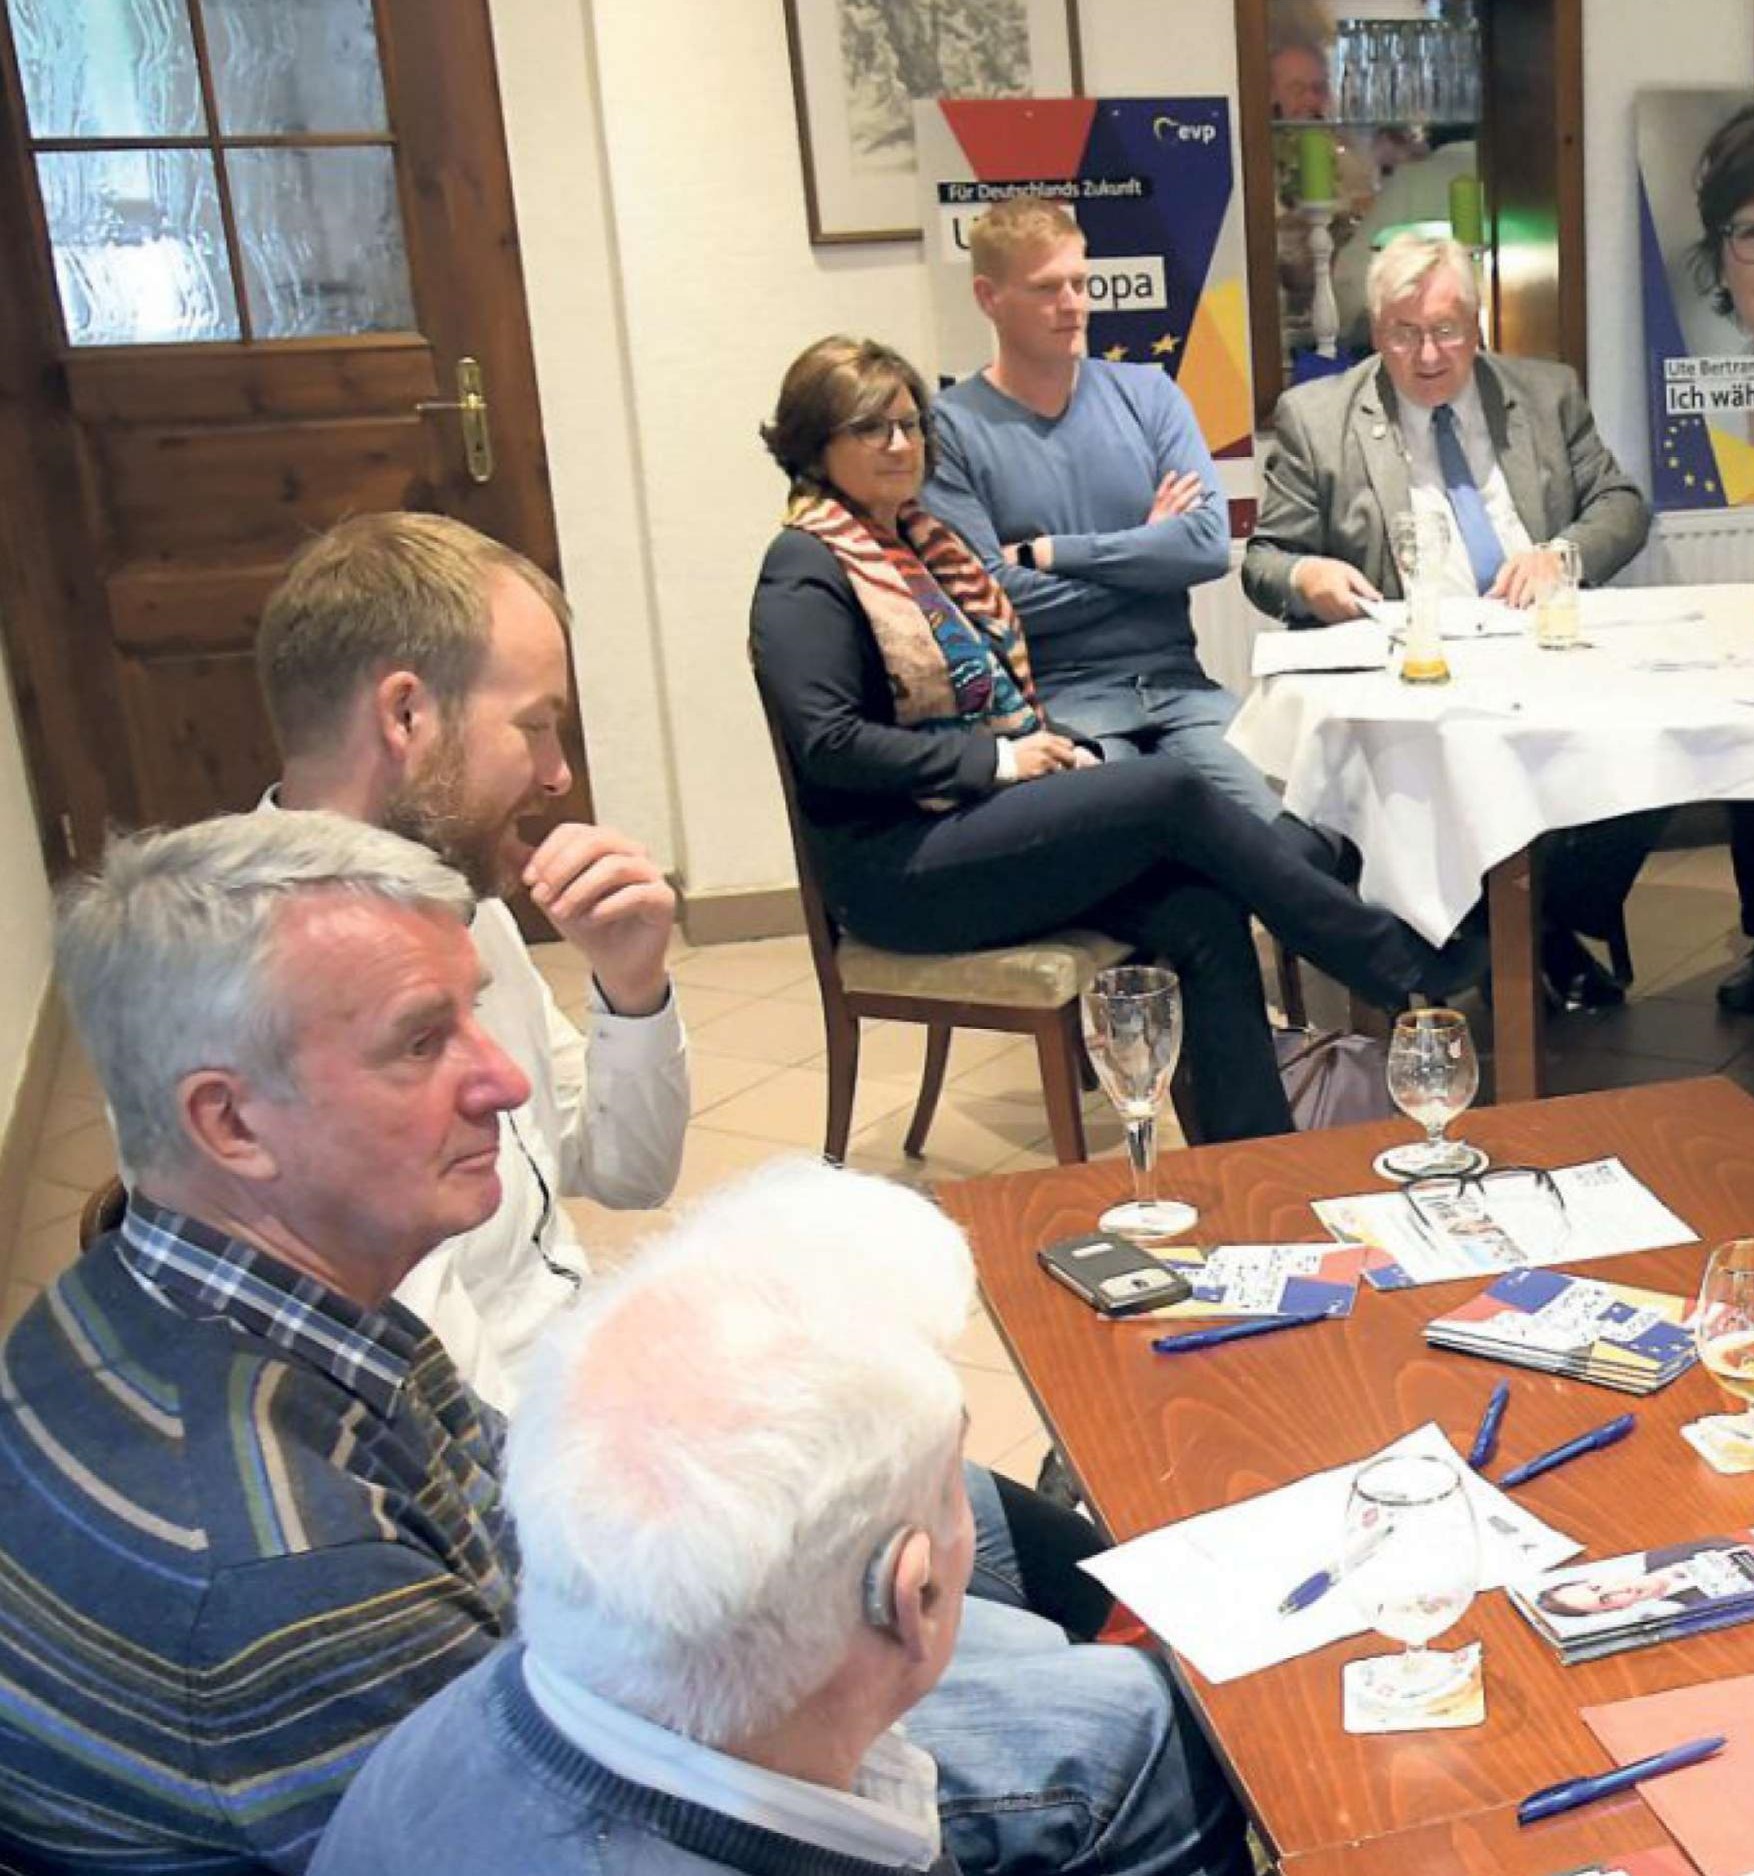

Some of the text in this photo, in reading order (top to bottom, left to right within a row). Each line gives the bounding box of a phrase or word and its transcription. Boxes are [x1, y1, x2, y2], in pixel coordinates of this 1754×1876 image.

[1178, 125, 1216, 145] evp
[949, 184, 974, 199] Für
[1084, 177, 1142, 196] Zukunft
[1088, 273, 1153, 310] opa
[1668, 363, 1695, 376] Ute
[1670, 385, 1705, 409] Ich
